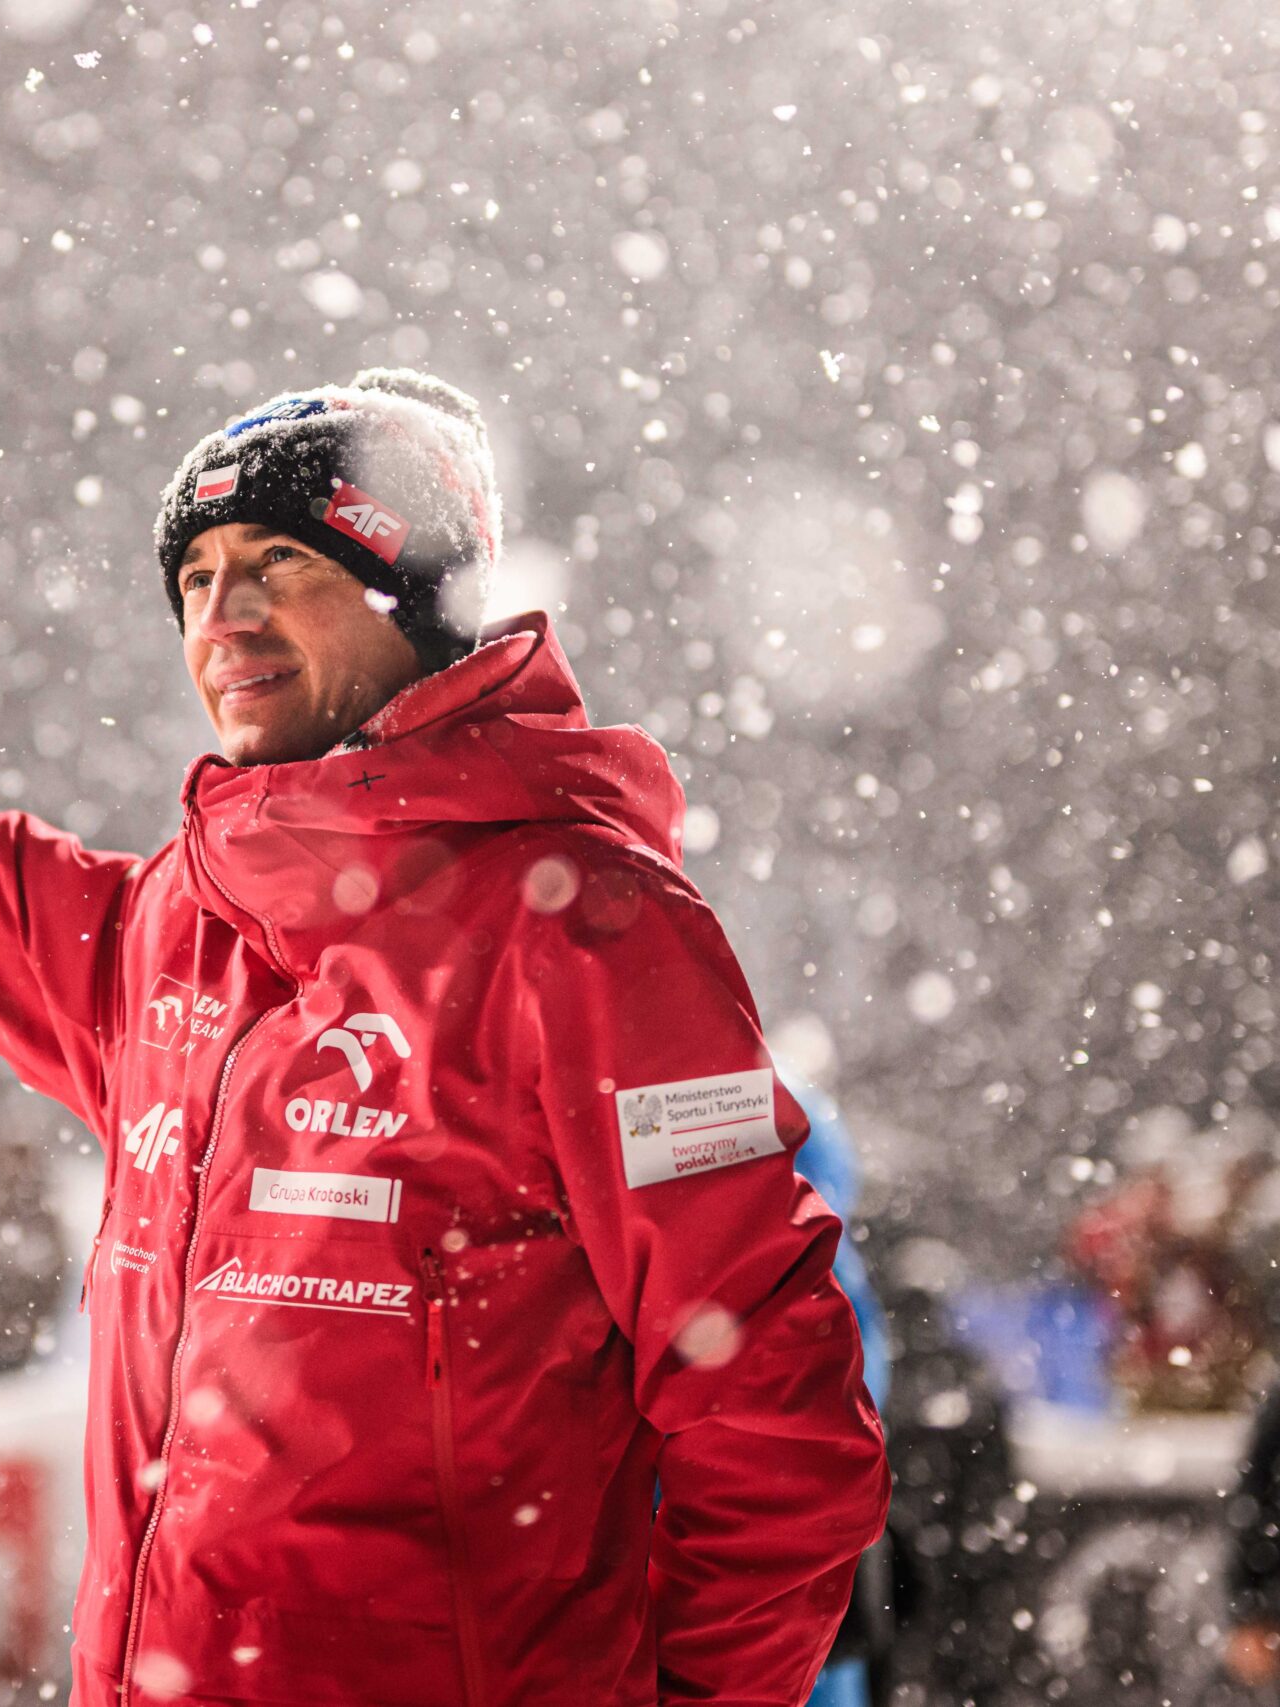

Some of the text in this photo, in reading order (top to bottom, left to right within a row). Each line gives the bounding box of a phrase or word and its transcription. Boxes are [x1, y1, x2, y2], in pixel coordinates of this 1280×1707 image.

[336, 503, 402, 539] 4F
[665, 1084, 742, 1105] Ministerstwo
[667, 1104, 707, 1122] Sportu
[716, 1094, 768, 1113] Turystyki
[284, 1097, 409, 1138] ORLEN
[124, 1101, 184, 1175] 4F
[672, 1137, 737, 1158] tworzymy
[675, 1152, 717, 1173] polski
[269, 1183, 369, 1206] Grupa Krotoski
[220, 1270, 413, 1308] BLACHOTRAPEZ
